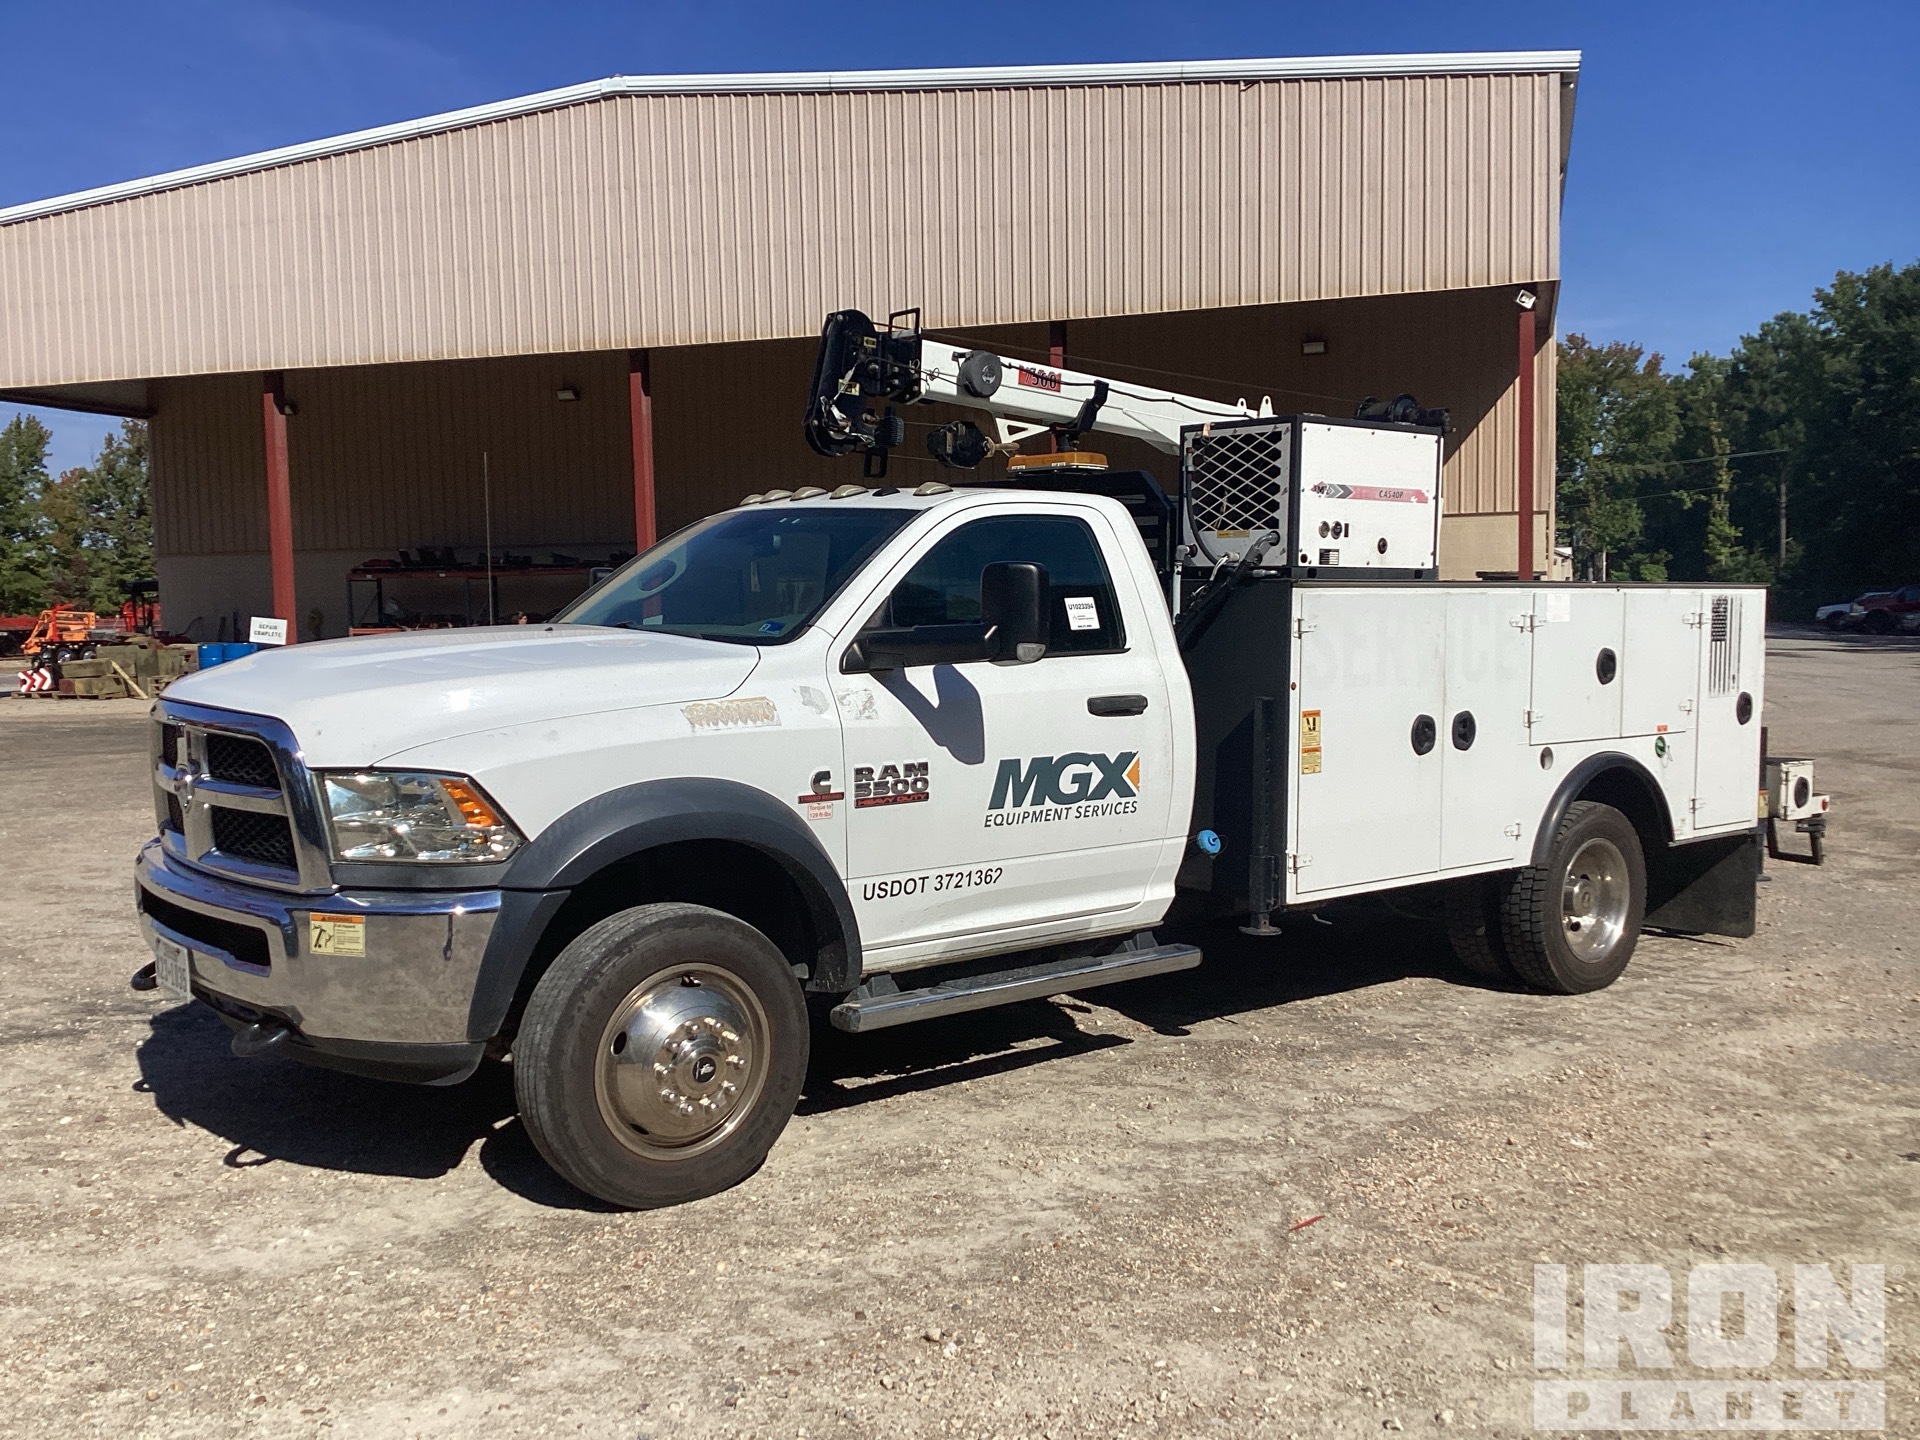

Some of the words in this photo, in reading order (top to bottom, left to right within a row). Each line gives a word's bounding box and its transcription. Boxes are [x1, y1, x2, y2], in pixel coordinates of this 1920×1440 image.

[253, 630, 282, 638] COMPLETE
[854, 762, 929, 782] RAM
[988, 751, 1139, 810] MGX
[854, 777, 929, 798] 5500
[857, 797, 895, 807] HEAVY
[896, 793, 928, 803] DUTY
[984, 807, 1072, 828] EQUIPMENT
[1074, 800, 1138, 819] SERVICES
[863, 876, 930, 901] USDOT
[933, 867, 1003, 892] 3721362
